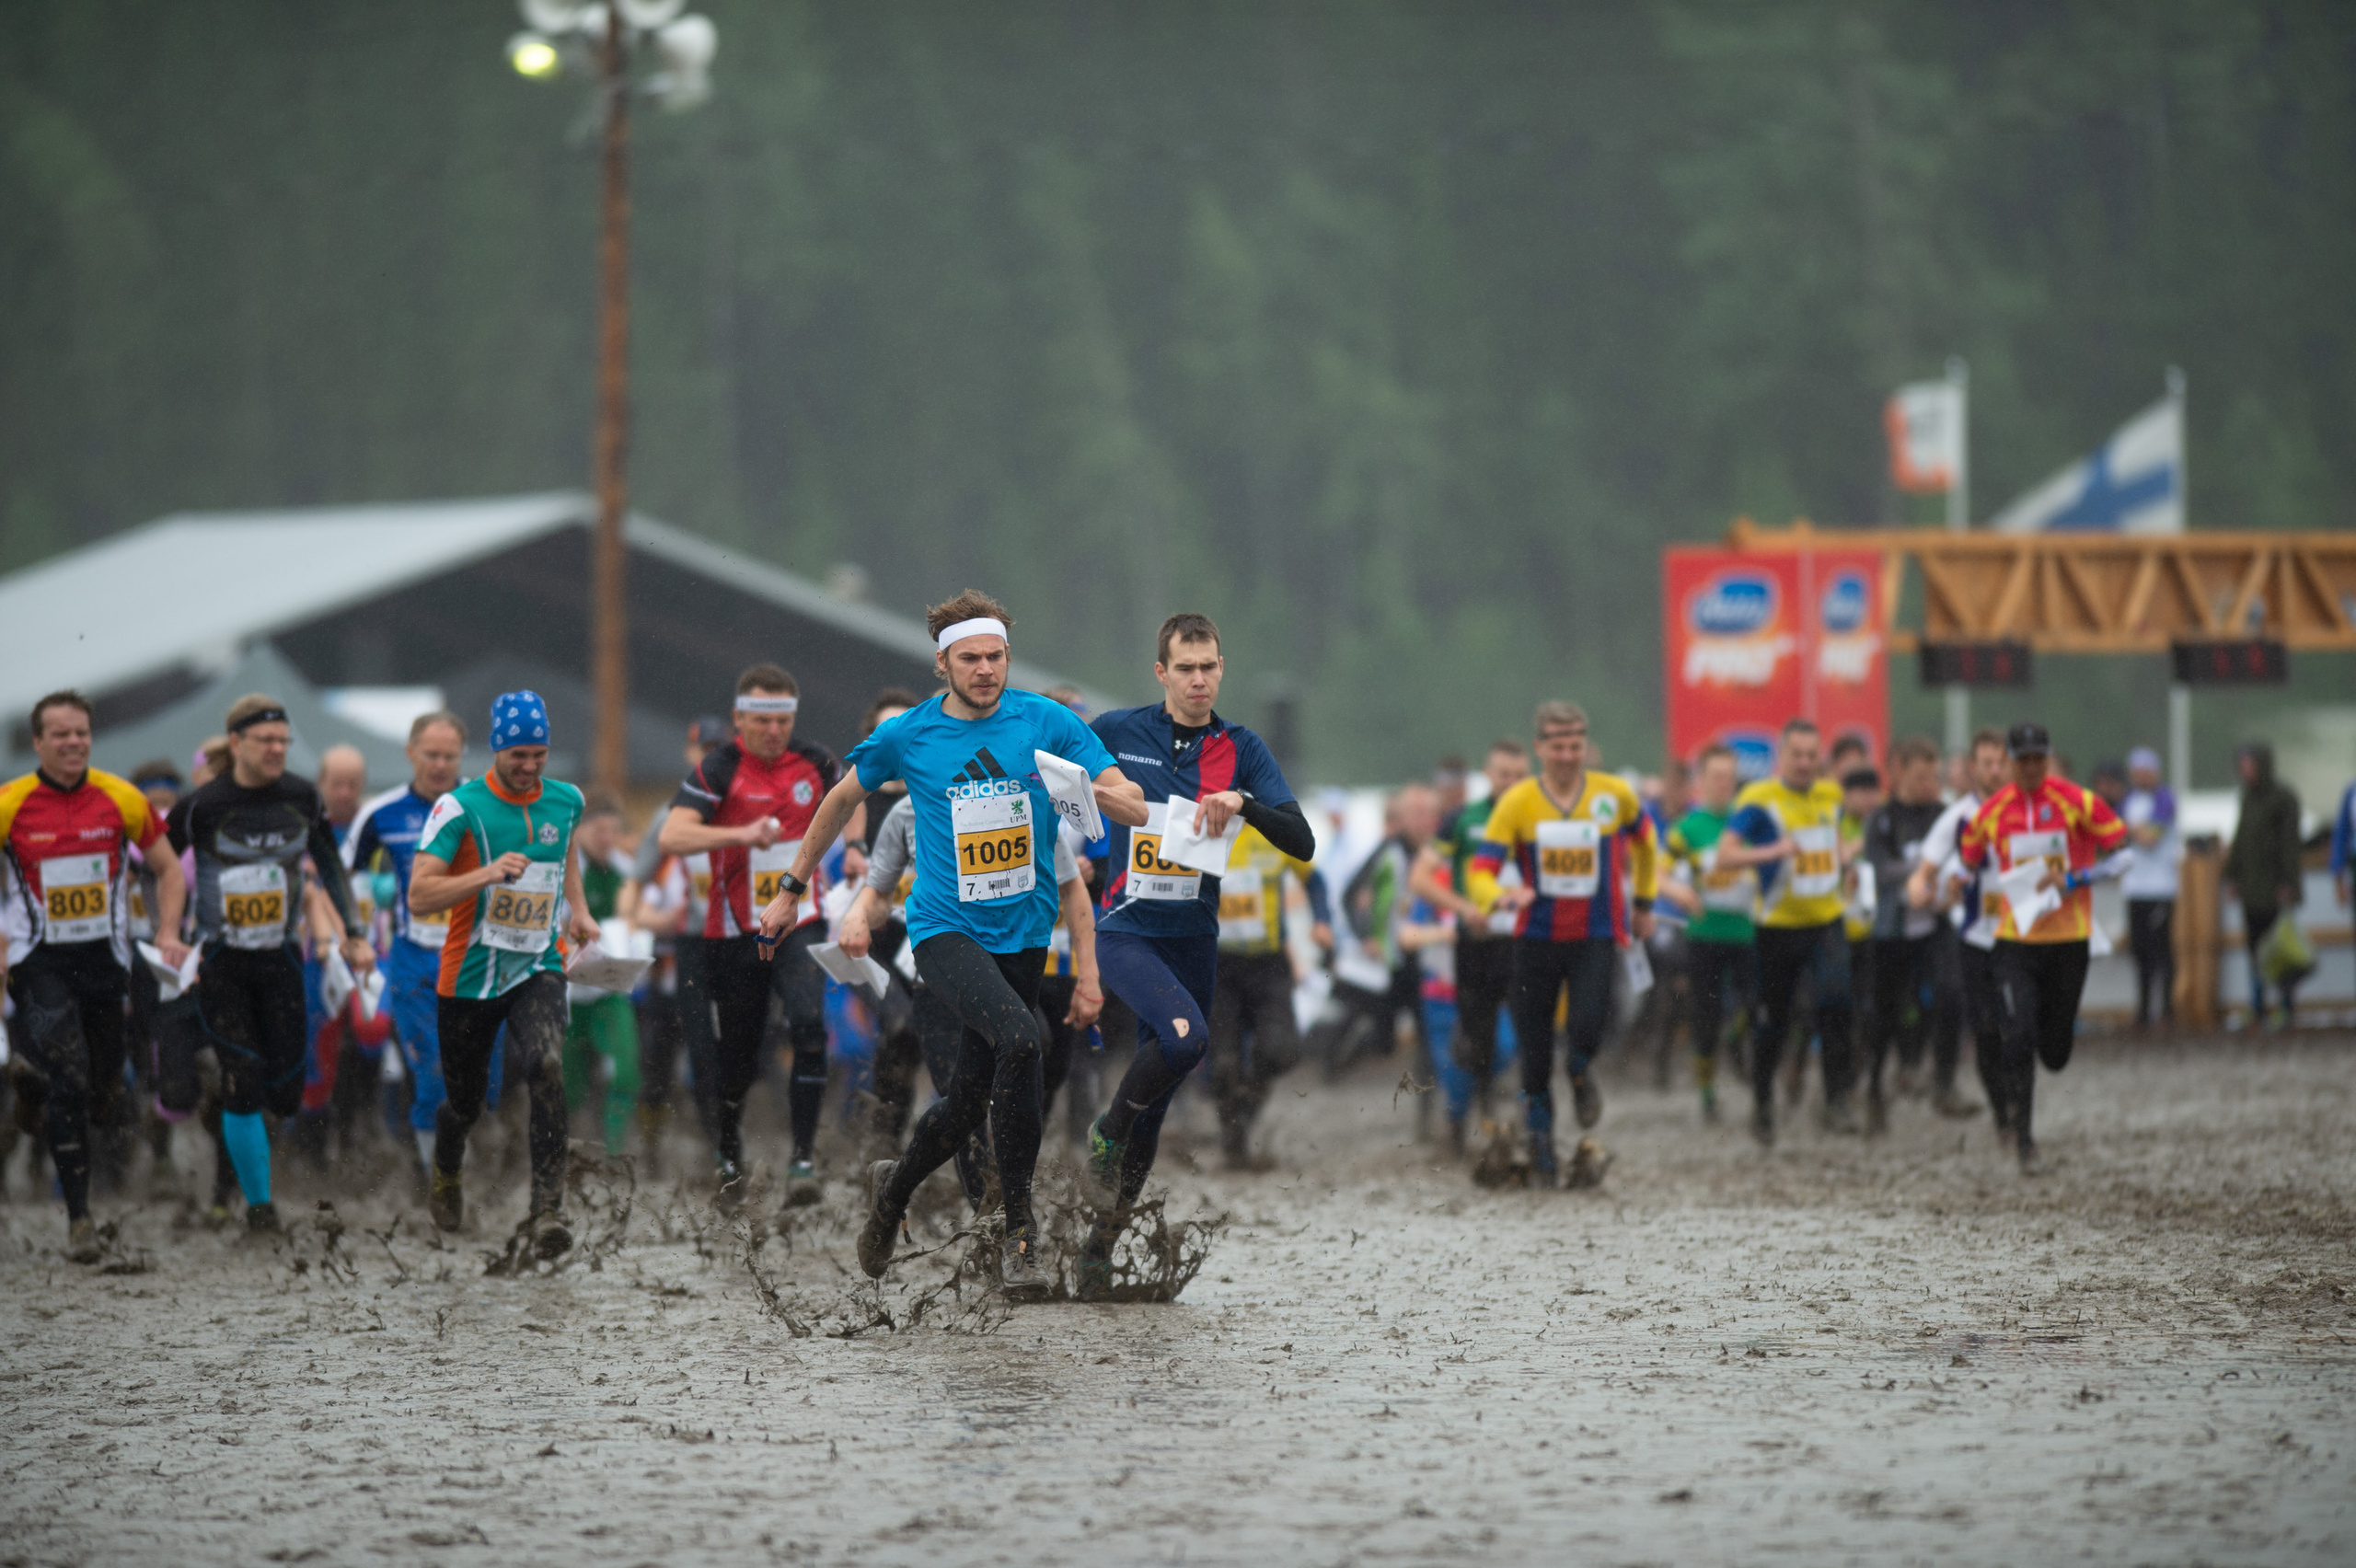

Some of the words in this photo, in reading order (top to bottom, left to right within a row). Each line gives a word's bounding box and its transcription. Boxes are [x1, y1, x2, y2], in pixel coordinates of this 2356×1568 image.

[1118, 752, 1162, 767] noname
[945, 778, 1022, 800] adidas
[1010, 814, 1027, 824] UPM
[963, 836, 1028, 866] 1005
[966, 882, 976, 896] 7
[1133, 880, 1141, 893] 7
[50, 887, 104, 917] 803
[228, 895, 281, 927] 602
[493, 894, 549, 926] 804
